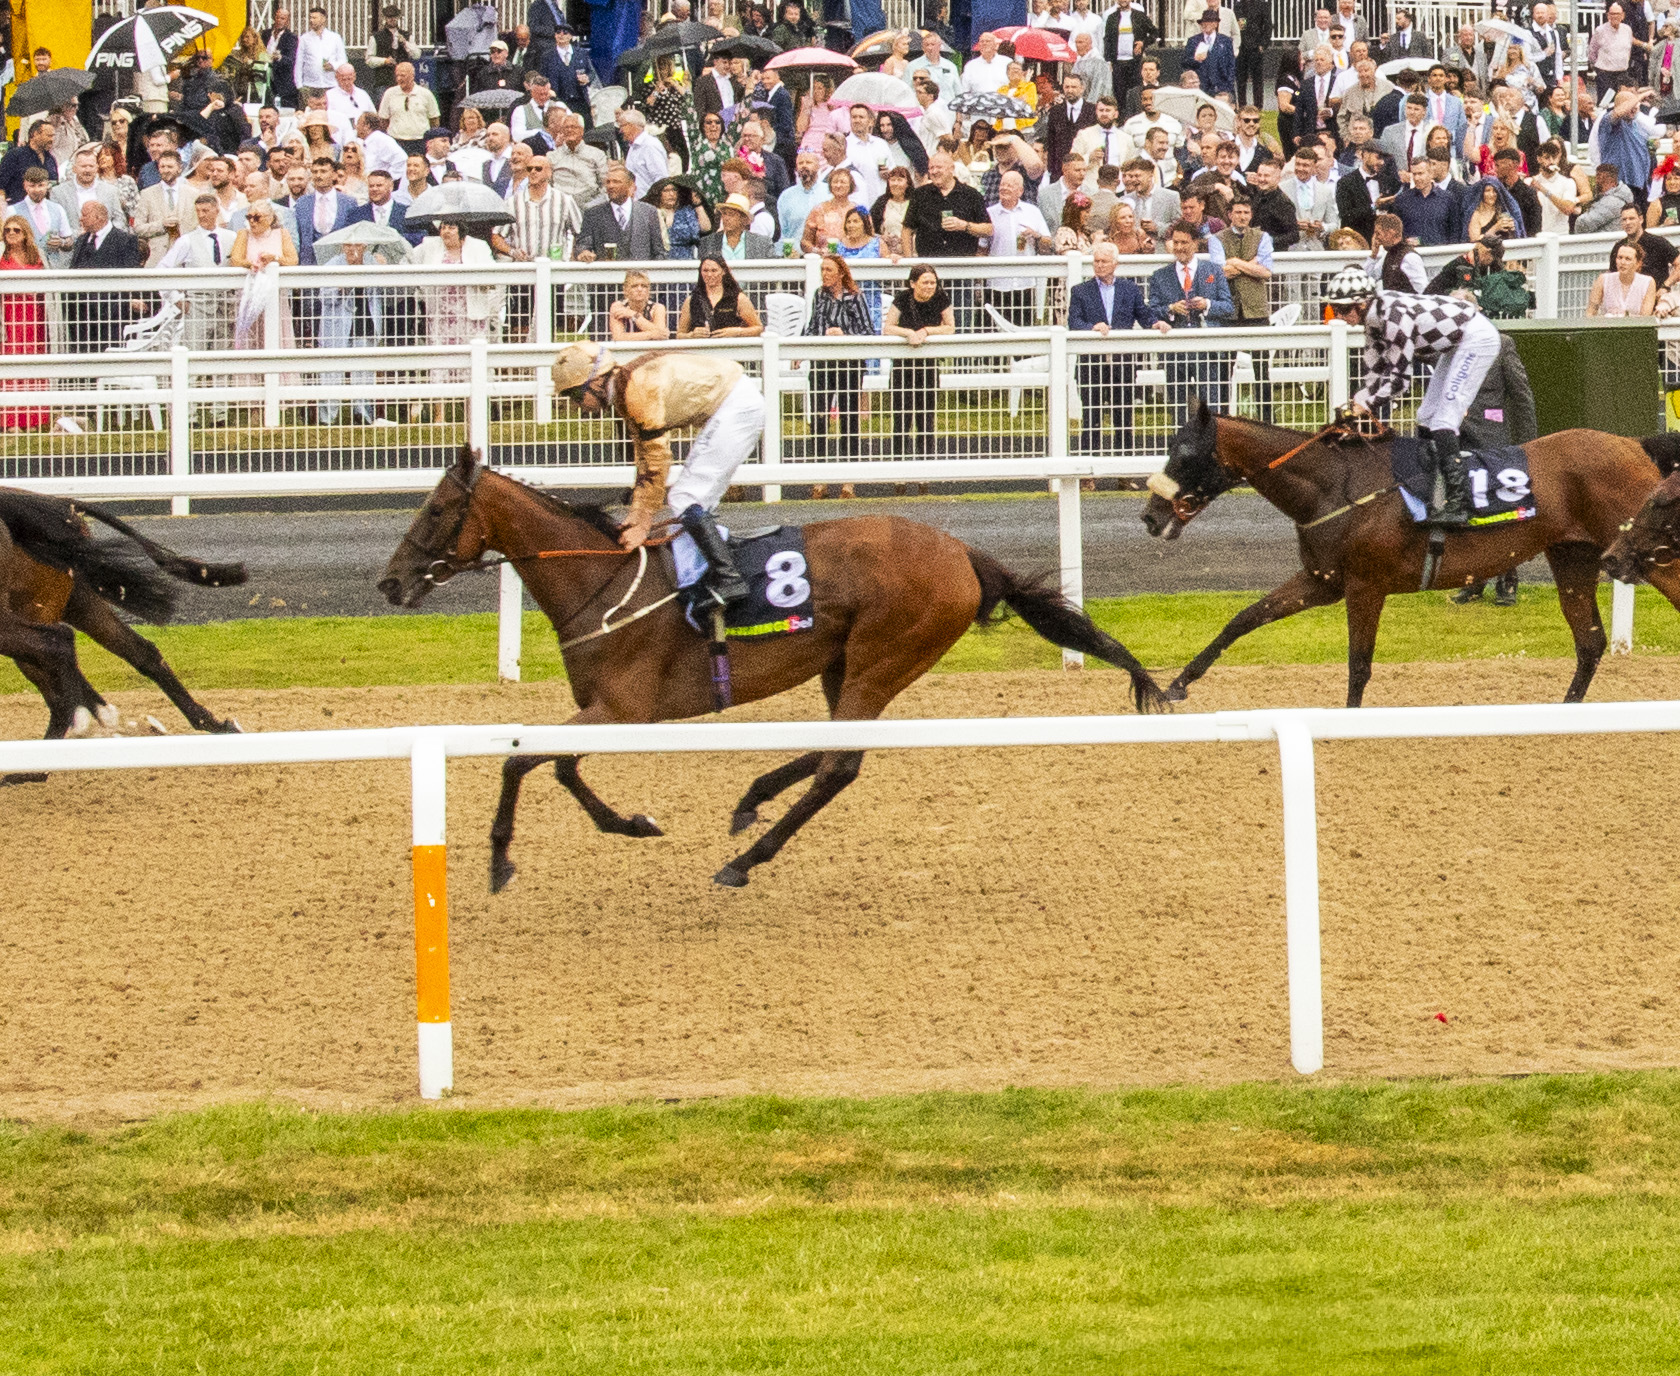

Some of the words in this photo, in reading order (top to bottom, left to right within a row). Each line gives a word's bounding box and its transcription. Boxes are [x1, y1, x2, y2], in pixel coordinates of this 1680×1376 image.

[162, 18, 204, 54] PING
[95, 51, 136, 68] PING
[764, 550, 811, 608] 8
